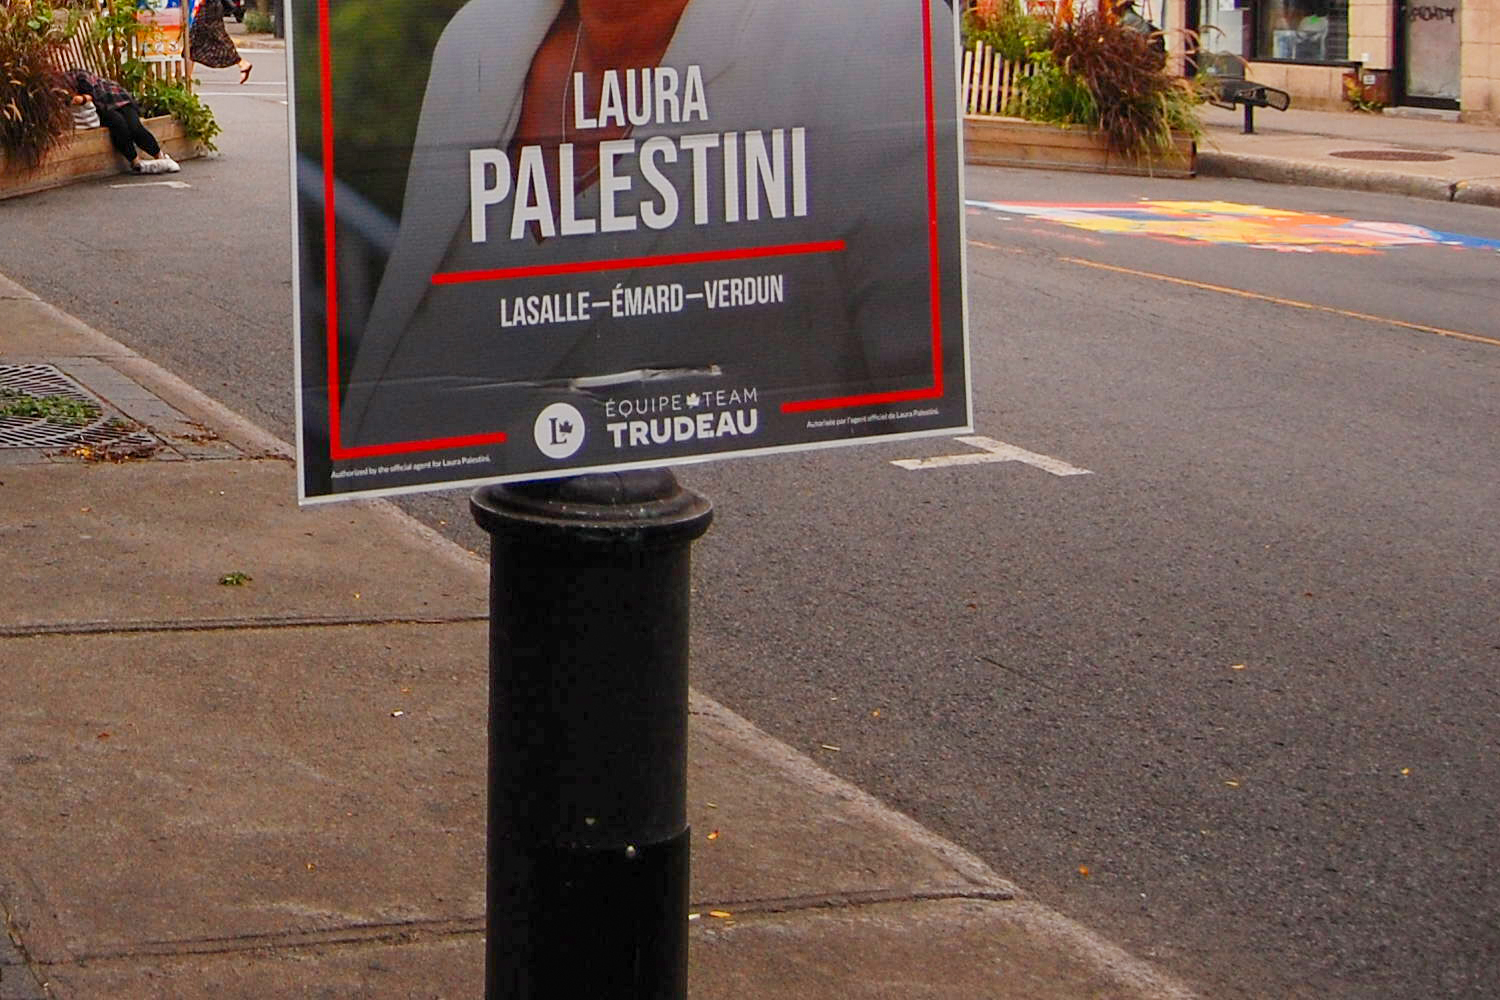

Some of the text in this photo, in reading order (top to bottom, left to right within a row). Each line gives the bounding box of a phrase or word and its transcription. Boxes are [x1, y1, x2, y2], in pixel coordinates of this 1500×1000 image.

[573, 64, 709, 130] LAURA
[469, 126, 807, 243] PALESTINI
[605, 387, 758, 419] ÉQUIPE TEAM
[896, 410, 913, 419] Laura
[607, 408, 759, 449] TRUDEAU
[331, 466, 368, 479] Authorized
[369, 466, 377, 476] by
[378, 465, 390, 474] the
[390, 461, 412, 472] official
[413, 460, 432, 472] agent
[432, 459, 442, 468] for
[443, 457, 461, 468] Laura
